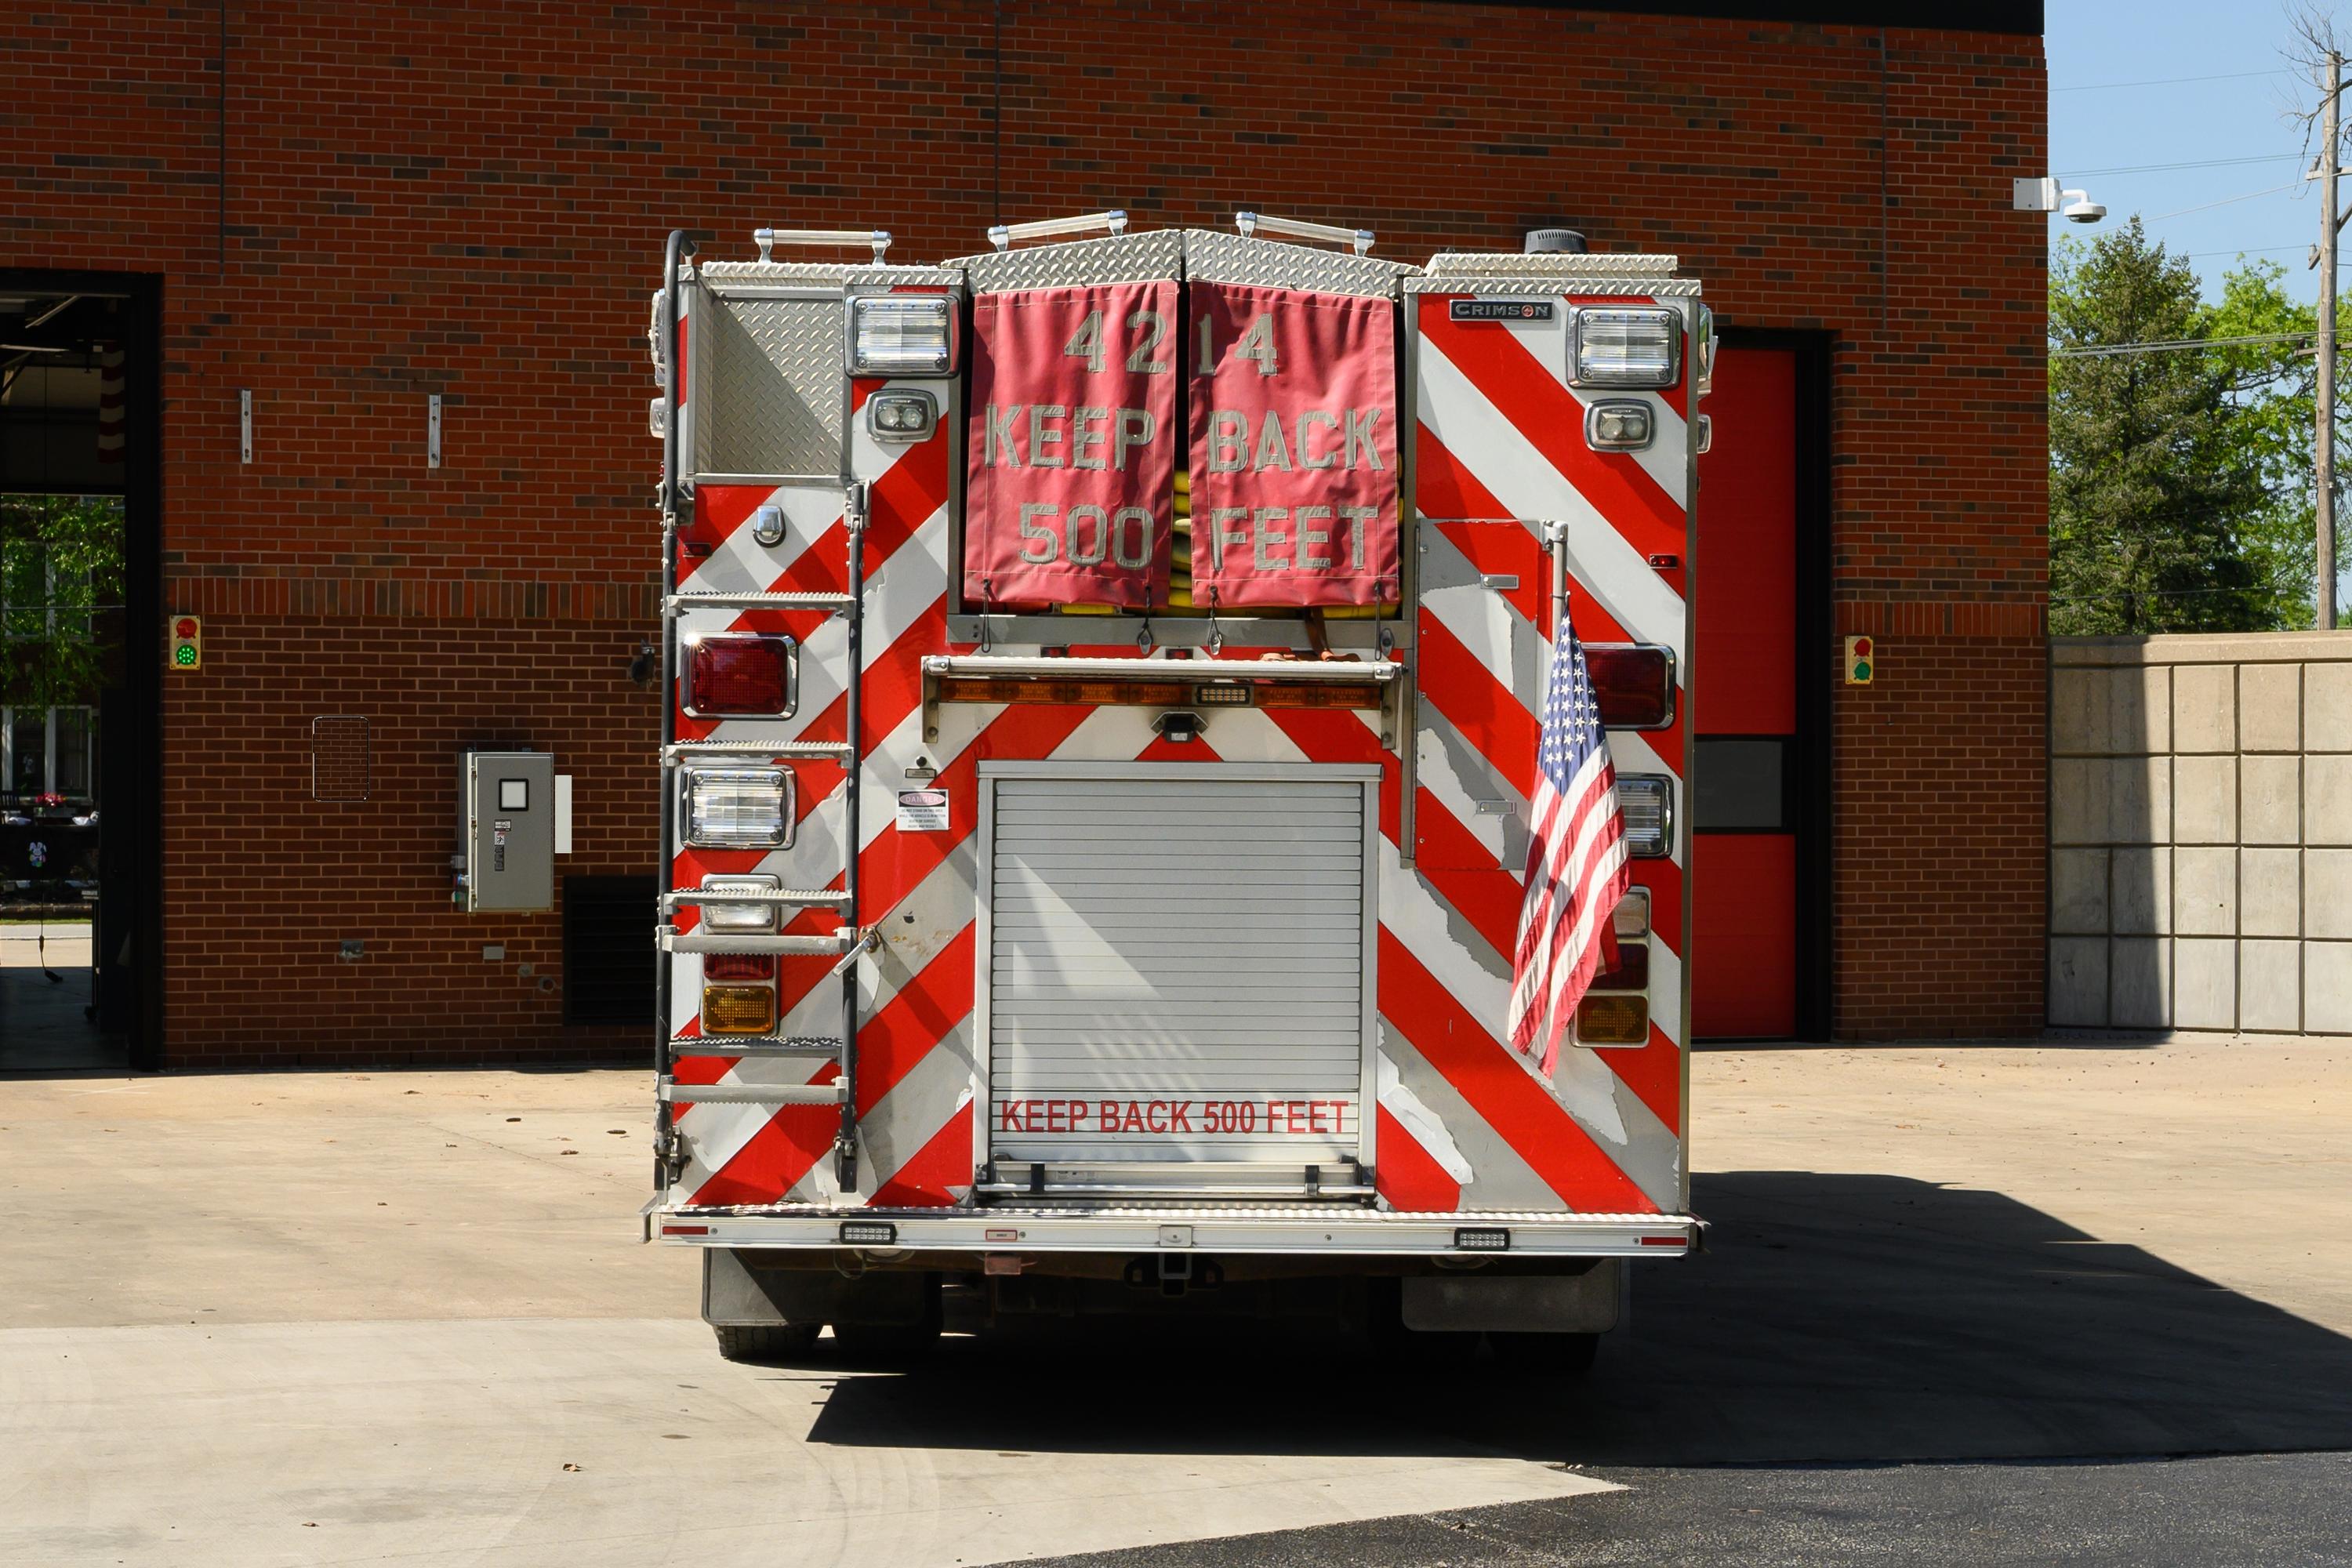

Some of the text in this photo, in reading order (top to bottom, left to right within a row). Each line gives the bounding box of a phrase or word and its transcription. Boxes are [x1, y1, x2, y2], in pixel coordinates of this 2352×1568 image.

[1455, 303, 1548, 318] CRIMSON
[984, 403, 1385, 472] KEEP BACK
[1019, 503, 1379, 572] 500 FEET
[1000, 1099, 1349, 1134] KEEP BACK 500 FEET
